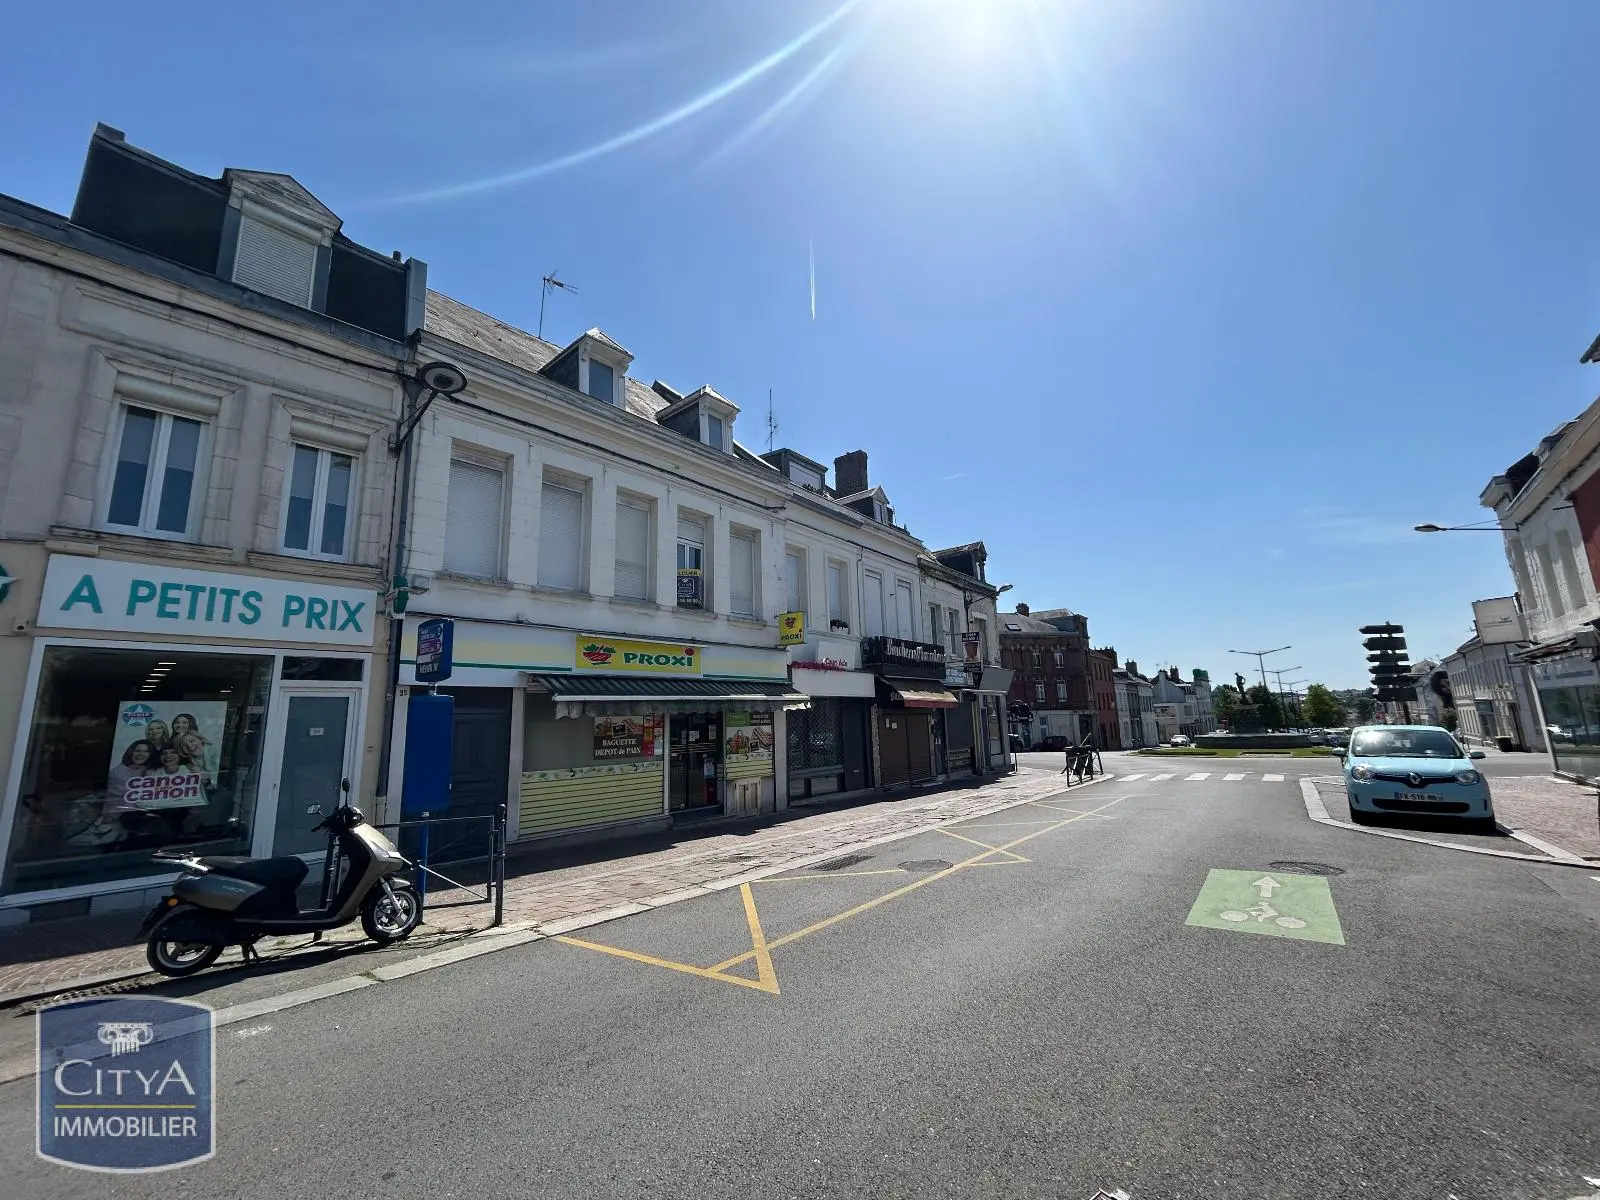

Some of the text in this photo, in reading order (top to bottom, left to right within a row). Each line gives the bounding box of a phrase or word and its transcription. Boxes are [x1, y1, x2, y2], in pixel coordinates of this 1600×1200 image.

[60, 574, 367, 633] A PETITS PRIX
[602, 738, 637, 746] BAGUETTE
[595, 748, 617, 756] DEPOT
[626, 746, 641, 755] PAIN
[127, 774, 200, 789] canon
[125, 787, 198, 802] canon
